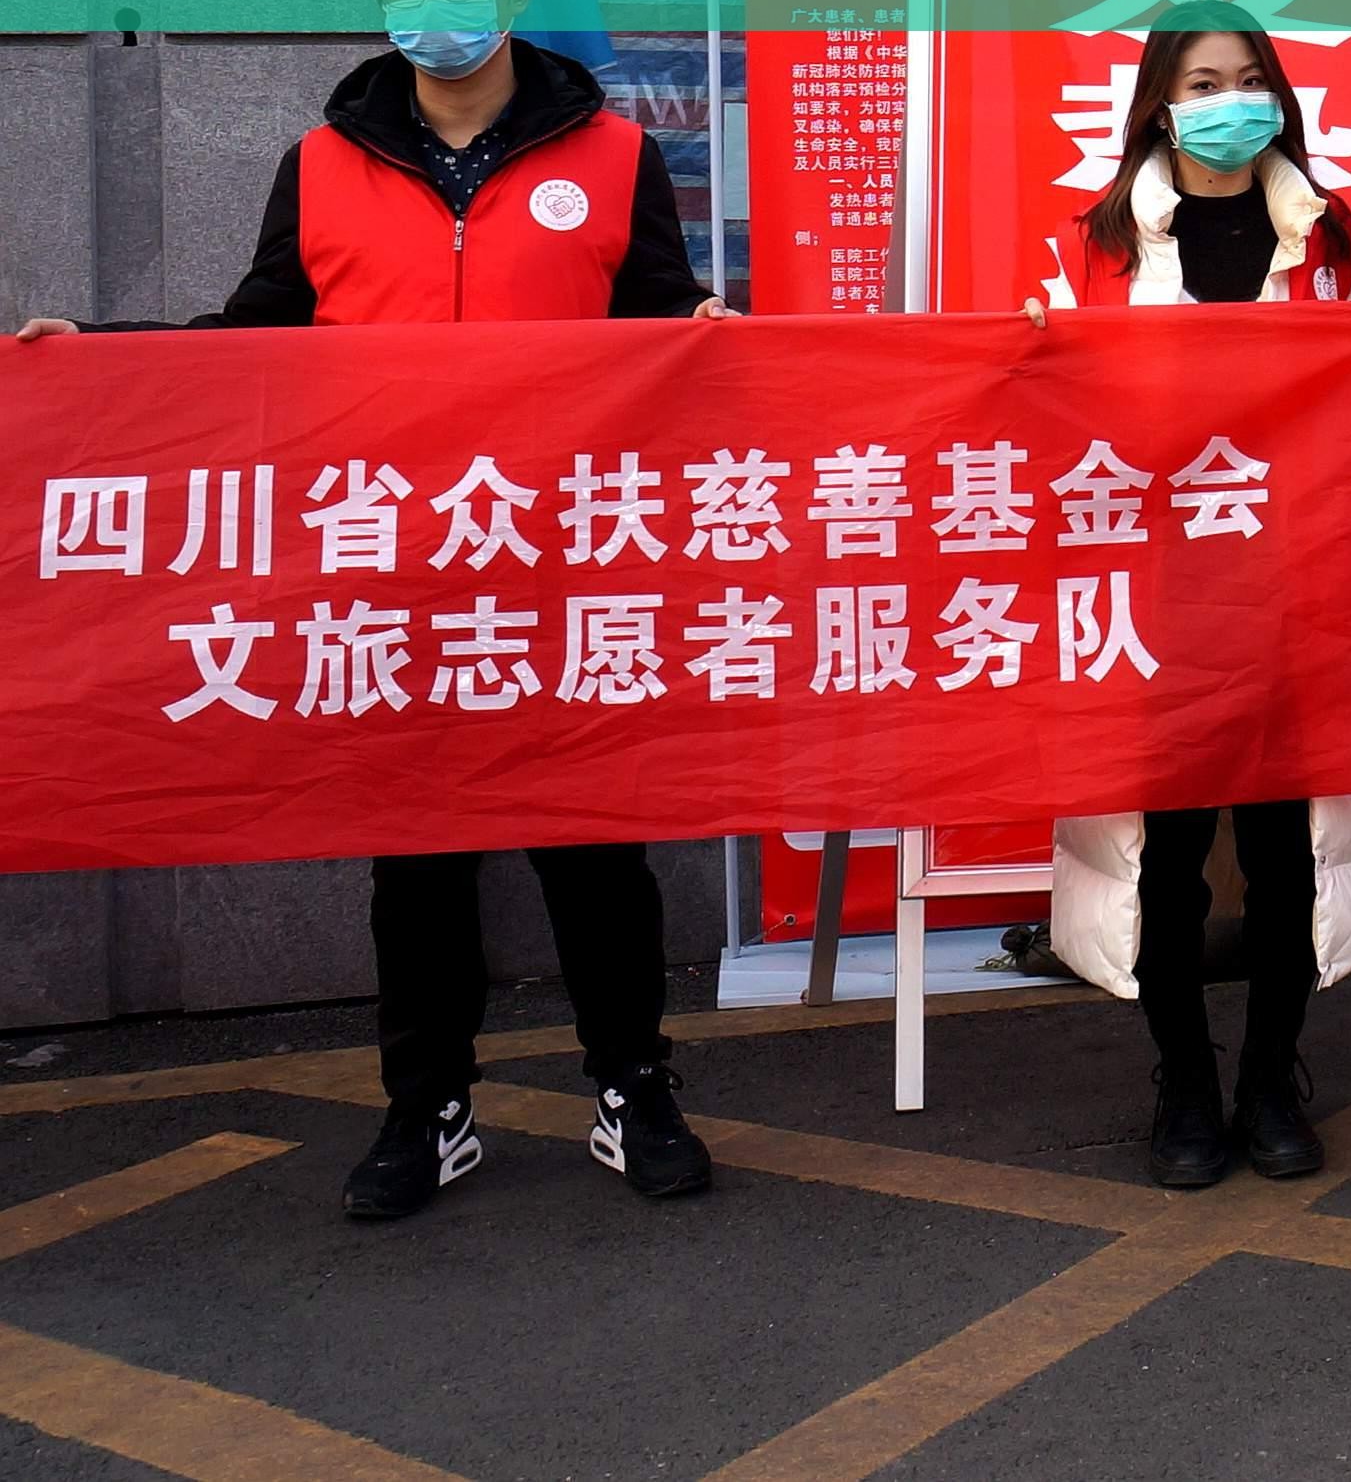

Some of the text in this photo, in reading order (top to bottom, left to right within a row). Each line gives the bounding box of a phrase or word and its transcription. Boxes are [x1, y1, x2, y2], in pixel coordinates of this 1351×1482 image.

[792, 63, 907, 79] 新冠肺炎防控指
[829, 193, 895, 208] 发热患者
[830, 211, 895, 227] 普通患者
[832, 285, 885, 301] 患者及
[40, 436, 1271, 579] 四川省众扶慈善基金会
[161, 571, 1160, 723] 文旅志愿者服务队
